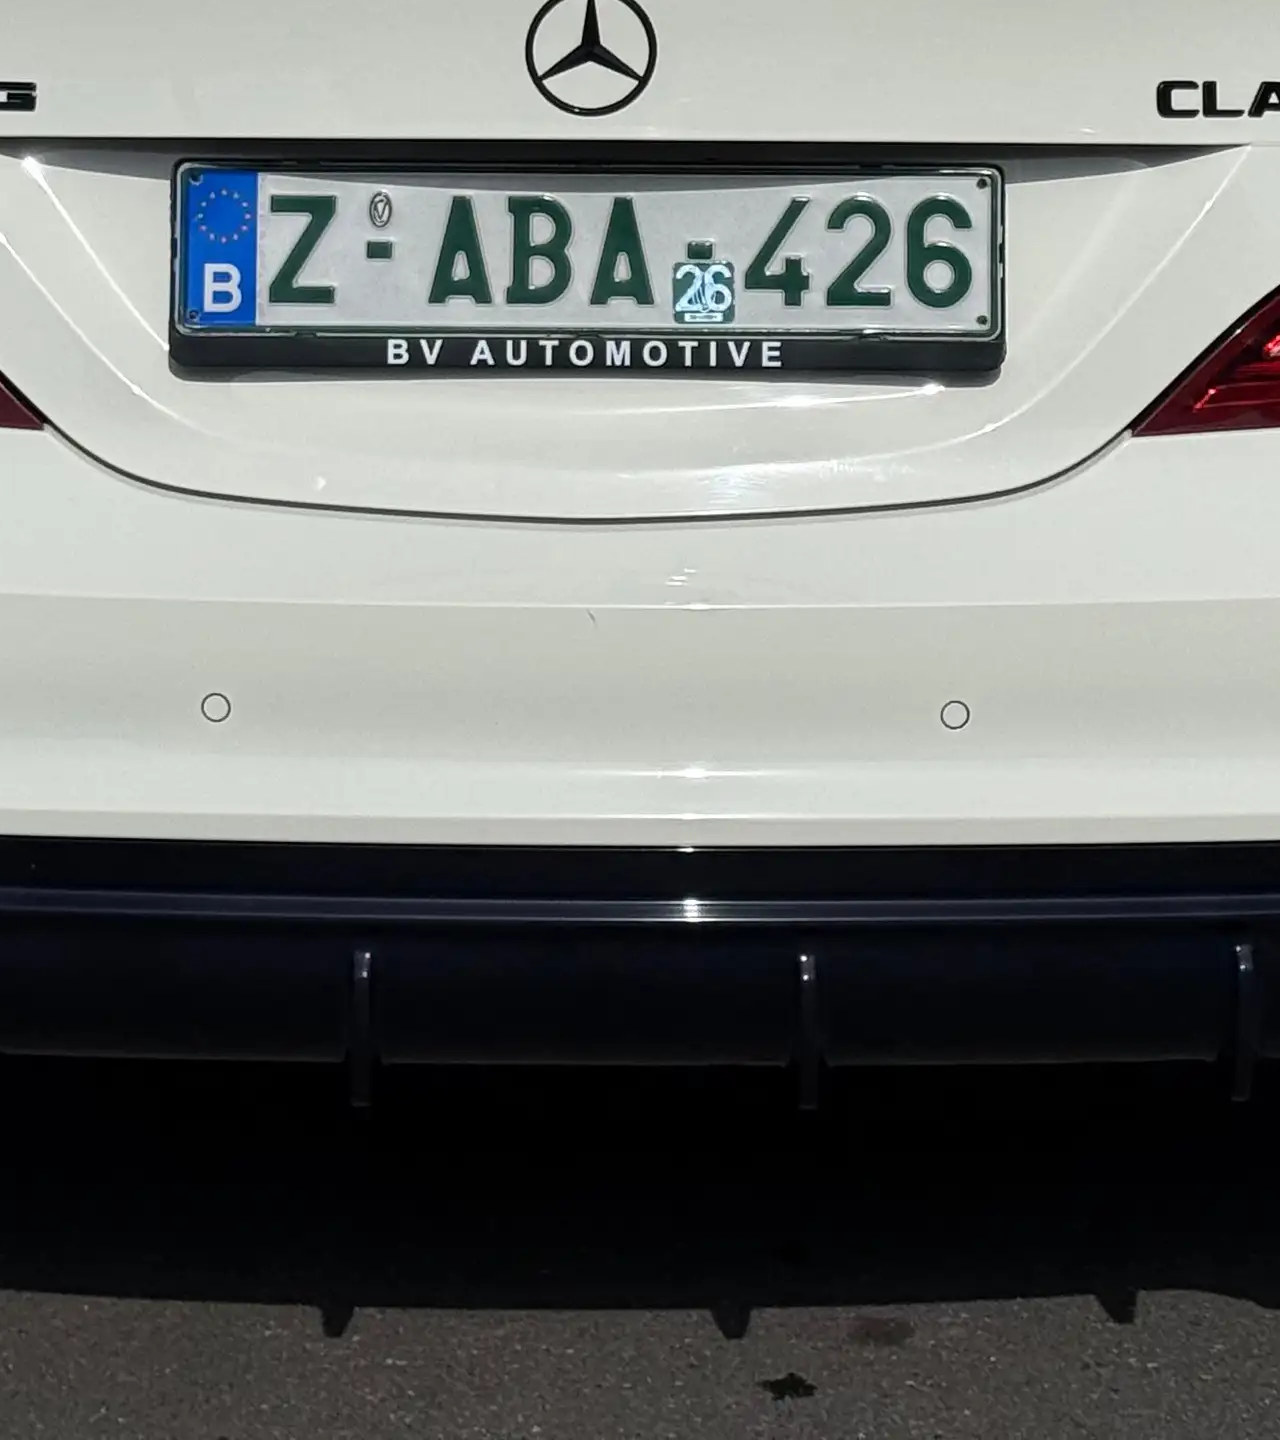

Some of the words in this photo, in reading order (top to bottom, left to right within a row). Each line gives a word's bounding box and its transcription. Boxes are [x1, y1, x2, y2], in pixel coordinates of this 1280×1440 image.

[204, 263, 242, 313] B
[675, 264, 733, 312] 26
[387, 339, 444, 365] BV
[470, 339, 783, 368] AUTOMOTIVE
